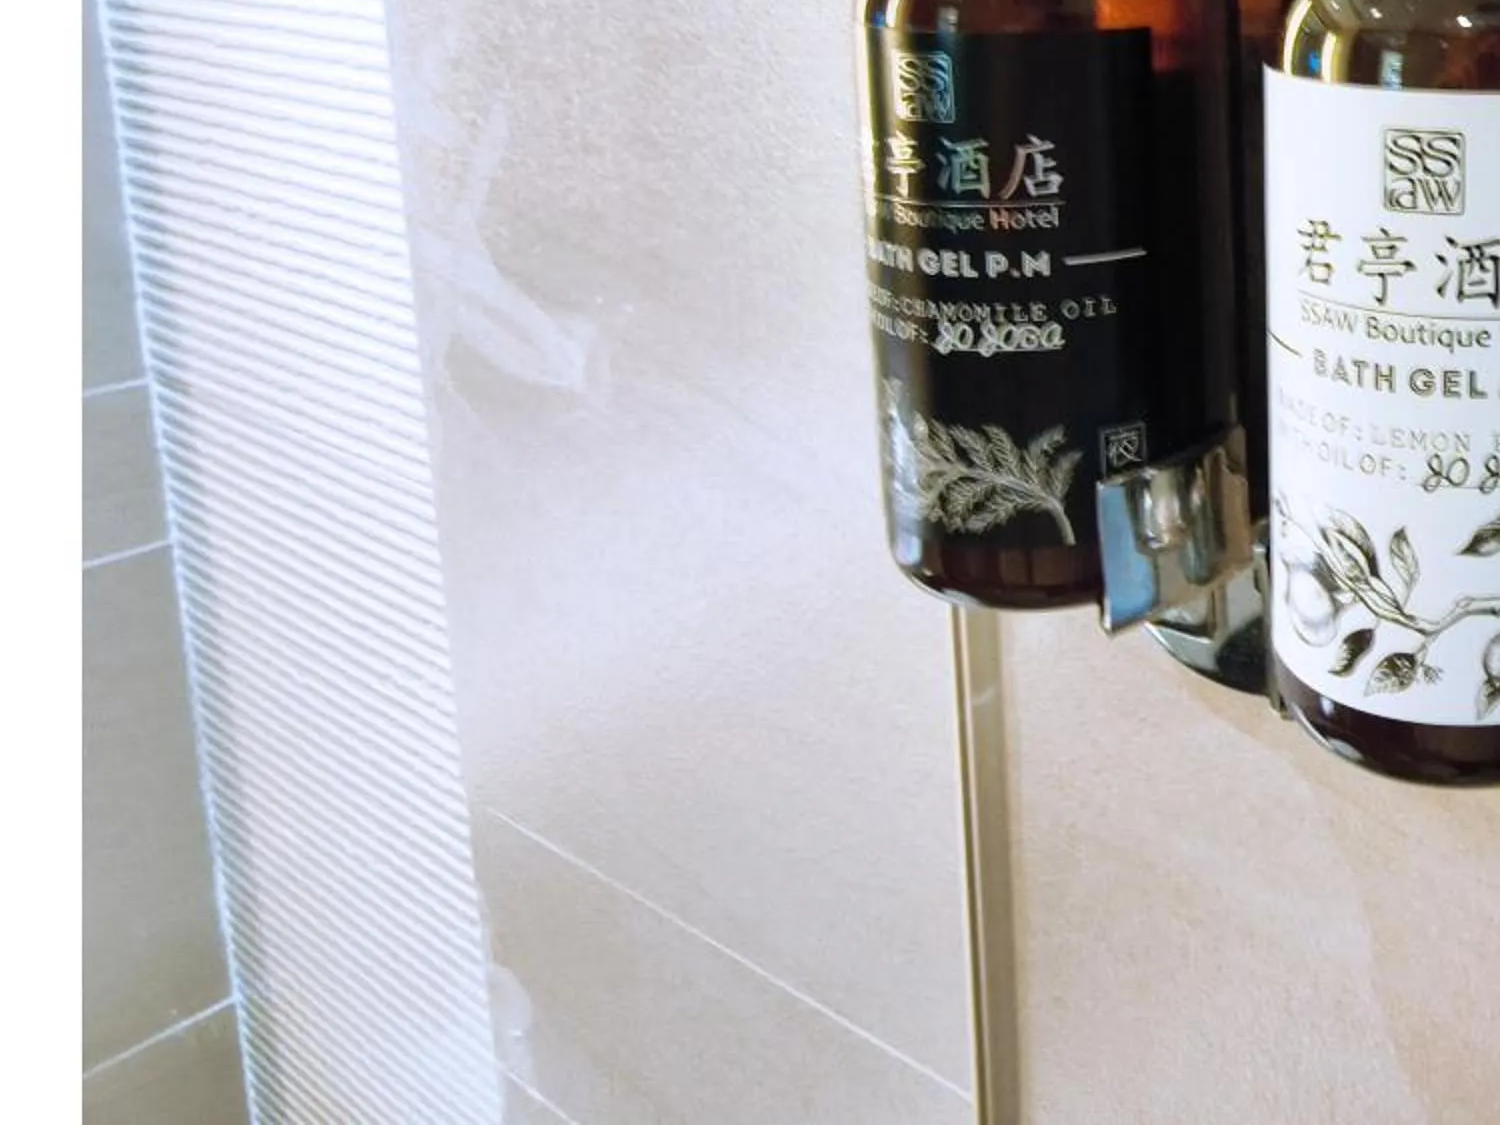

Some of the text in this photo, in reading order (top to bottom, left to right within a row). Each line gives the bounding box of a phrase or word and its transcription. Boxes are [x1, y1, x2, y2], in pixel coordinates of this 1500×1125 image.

[880, 130, 1065, 201] 亭酒店
[1388, 134, 1461, 177] SS
[893, 204, 1060, 233] Bouque Hotel
[916, 248, 979, 278] GEL
[984, 250, 1052, 279] P.M
[900, 296, 1048, 324] CHAMOMILE
[1060, 294, 1118, 321] OIL
[1300, 299, 1357, 336] SSAW
[1364, 316, 1493, 355] Boutique
[1311, 348, 1397, 395] BATH
[1408, 368, 1488, 400] GEL
[1370, 423, 1472, 454] LEMON
